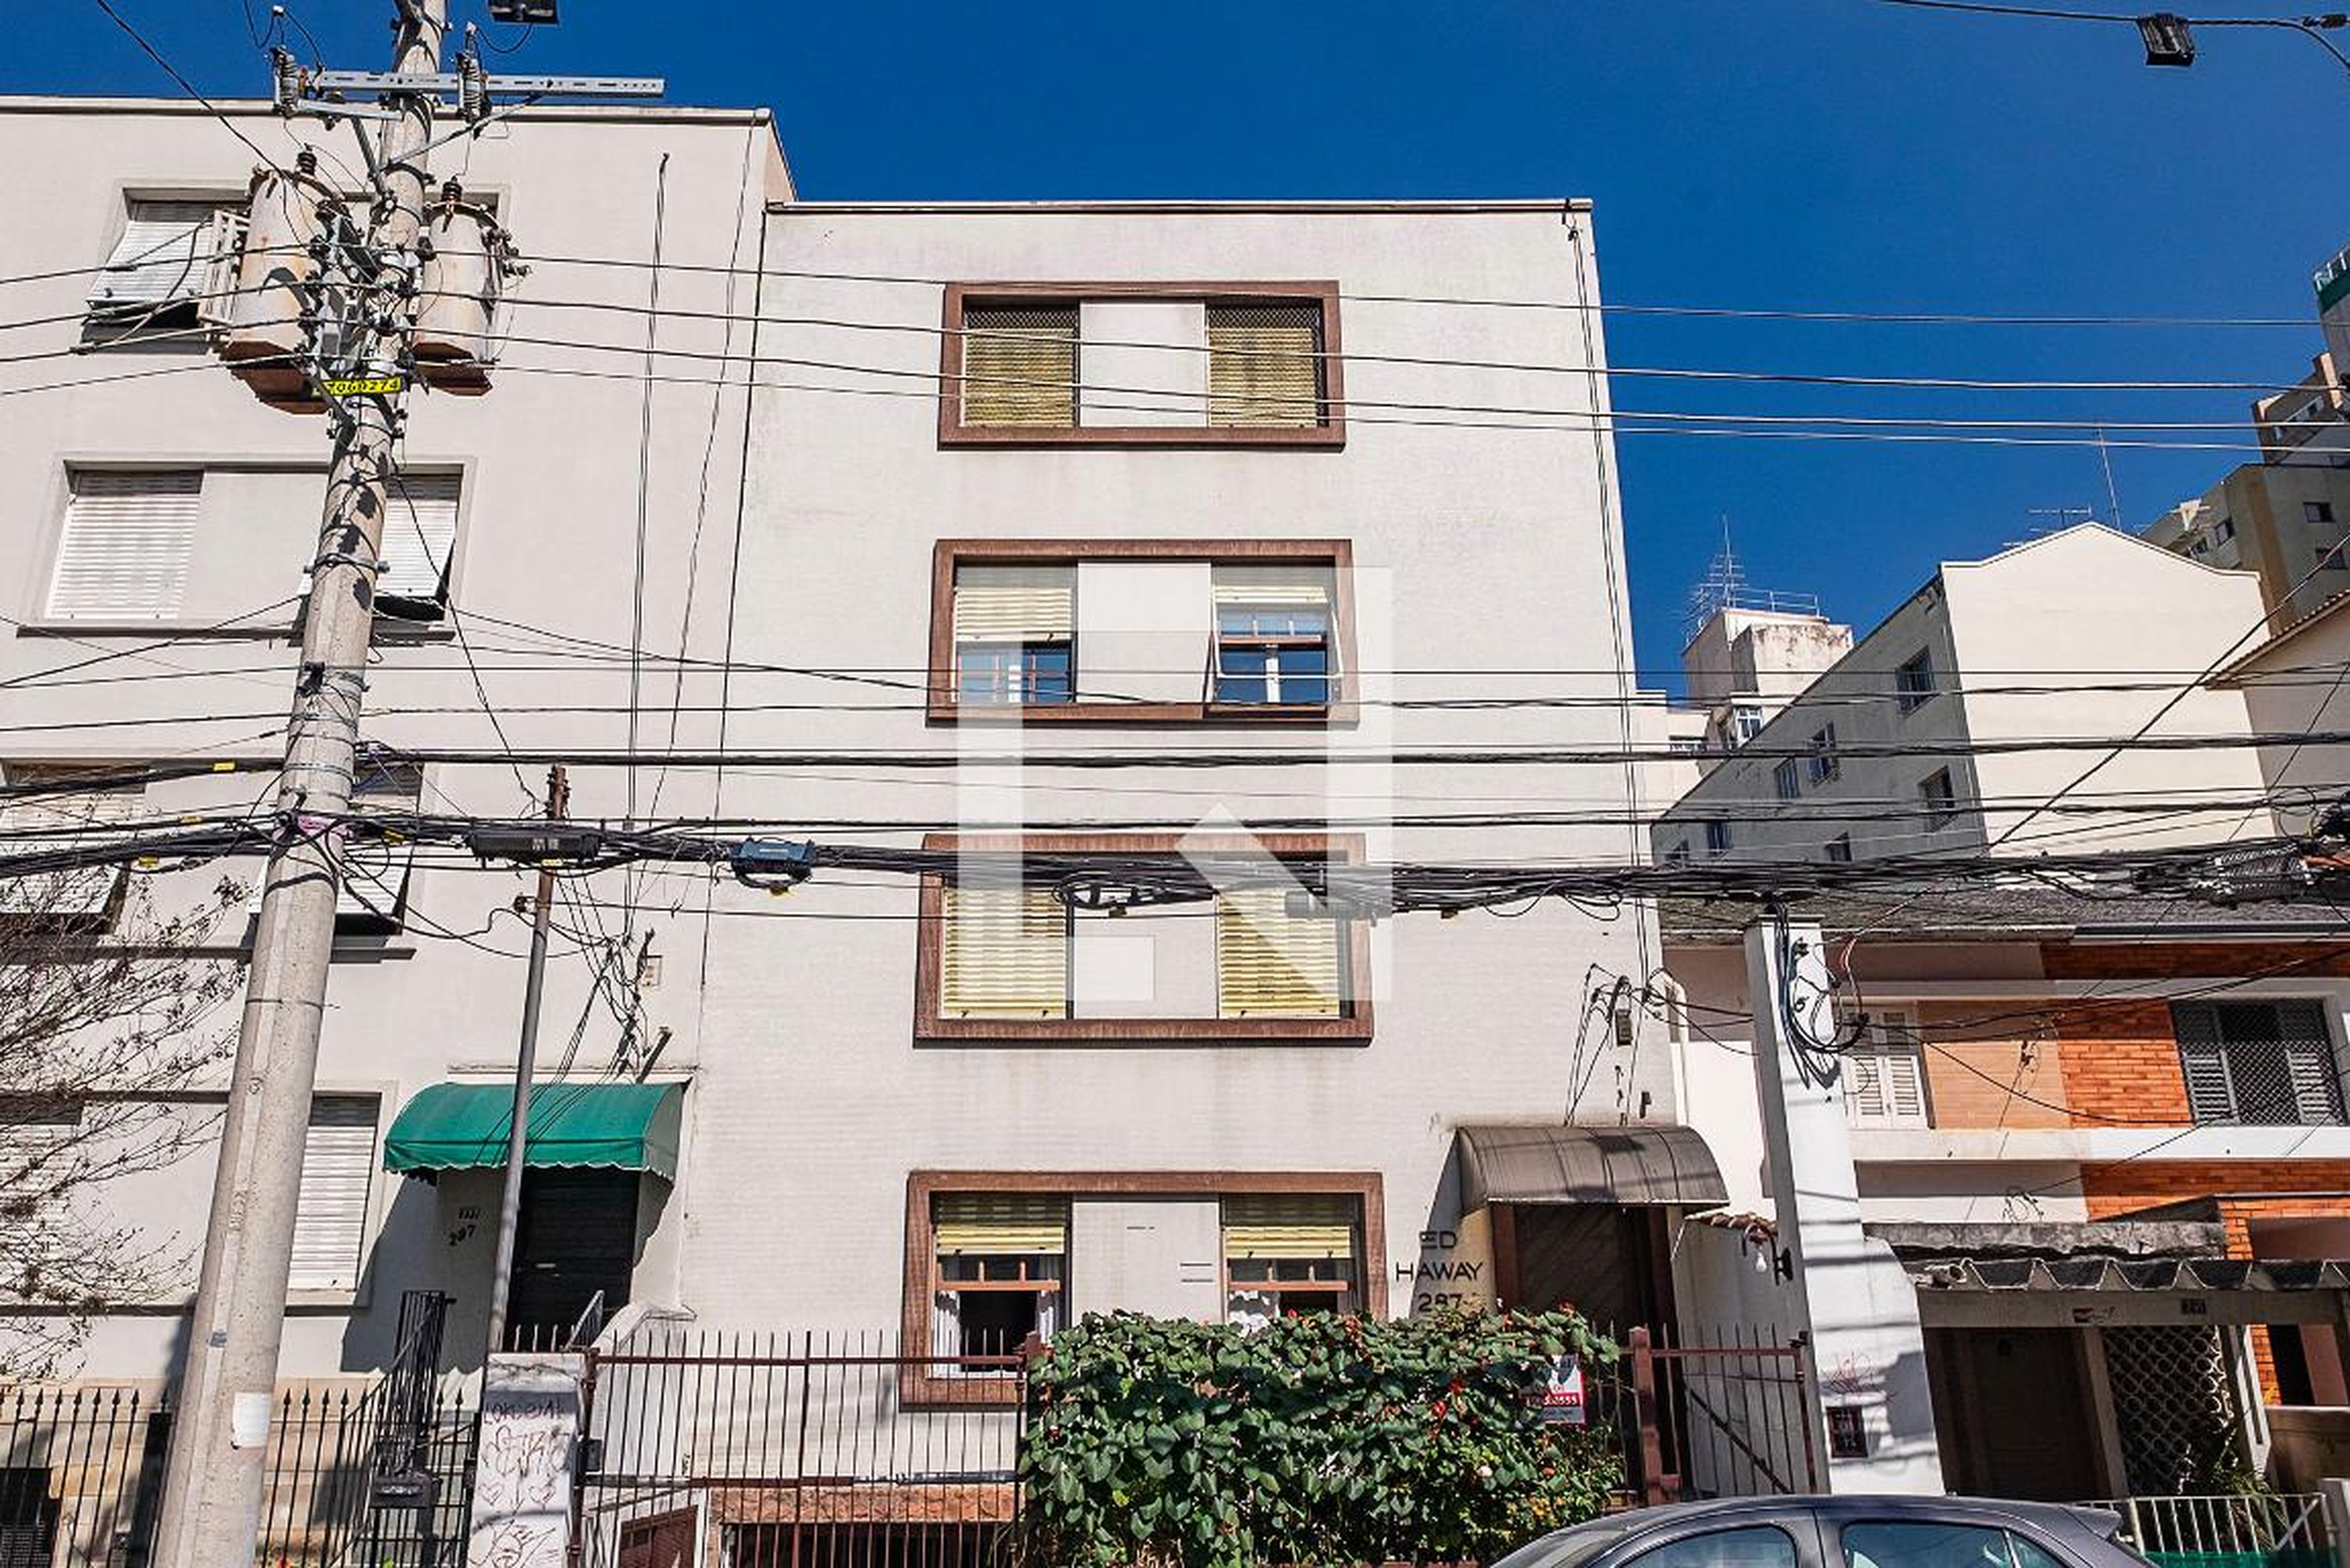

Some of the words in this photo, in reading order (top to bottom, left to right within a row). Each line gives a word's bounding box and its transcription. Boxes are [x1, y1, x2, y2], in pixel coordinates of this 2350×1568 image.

[1420, 1231, 1457, 1249] ED
[1396, 1262, 1483, 1282] HAWAY
[1418, 1293, 1463, 1312] 287
